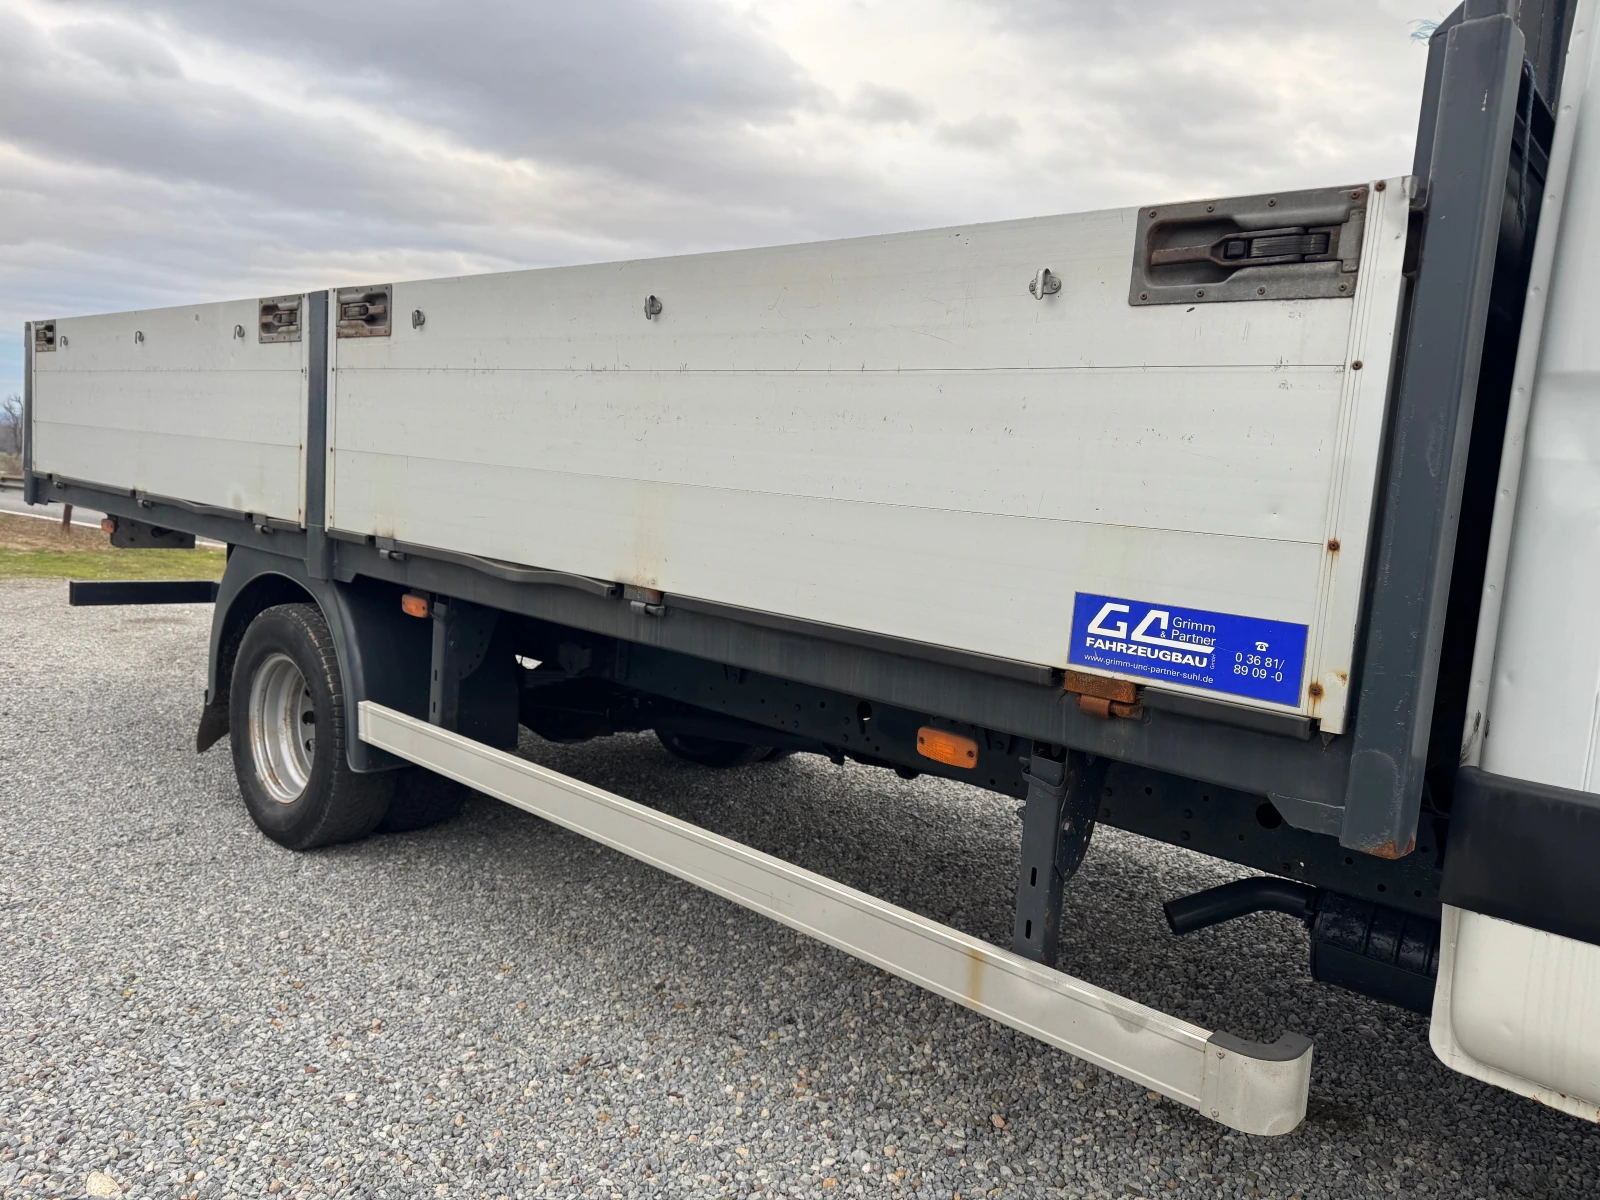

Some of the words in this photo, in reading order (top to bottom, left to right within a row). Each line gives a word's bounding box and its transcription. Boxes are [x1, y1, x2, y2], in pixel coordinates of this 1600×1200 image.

[1172, 616, 1216, 634] Grimm
[1160, 630, 1167, 639] &
[1171, 629, 1217, 646] Partner
[1085, 636, 1209, 668] FAHRZEUGBAU
[1235, 652, 1243, 662] 0
[1246, 654, 1262, 666] 36
[1083, 653, 1214, 684] www.grimm-und-partner-suhl.de
[1233, 664, 1249, 676] 89
[1252, 667, 1267, 679] 09
